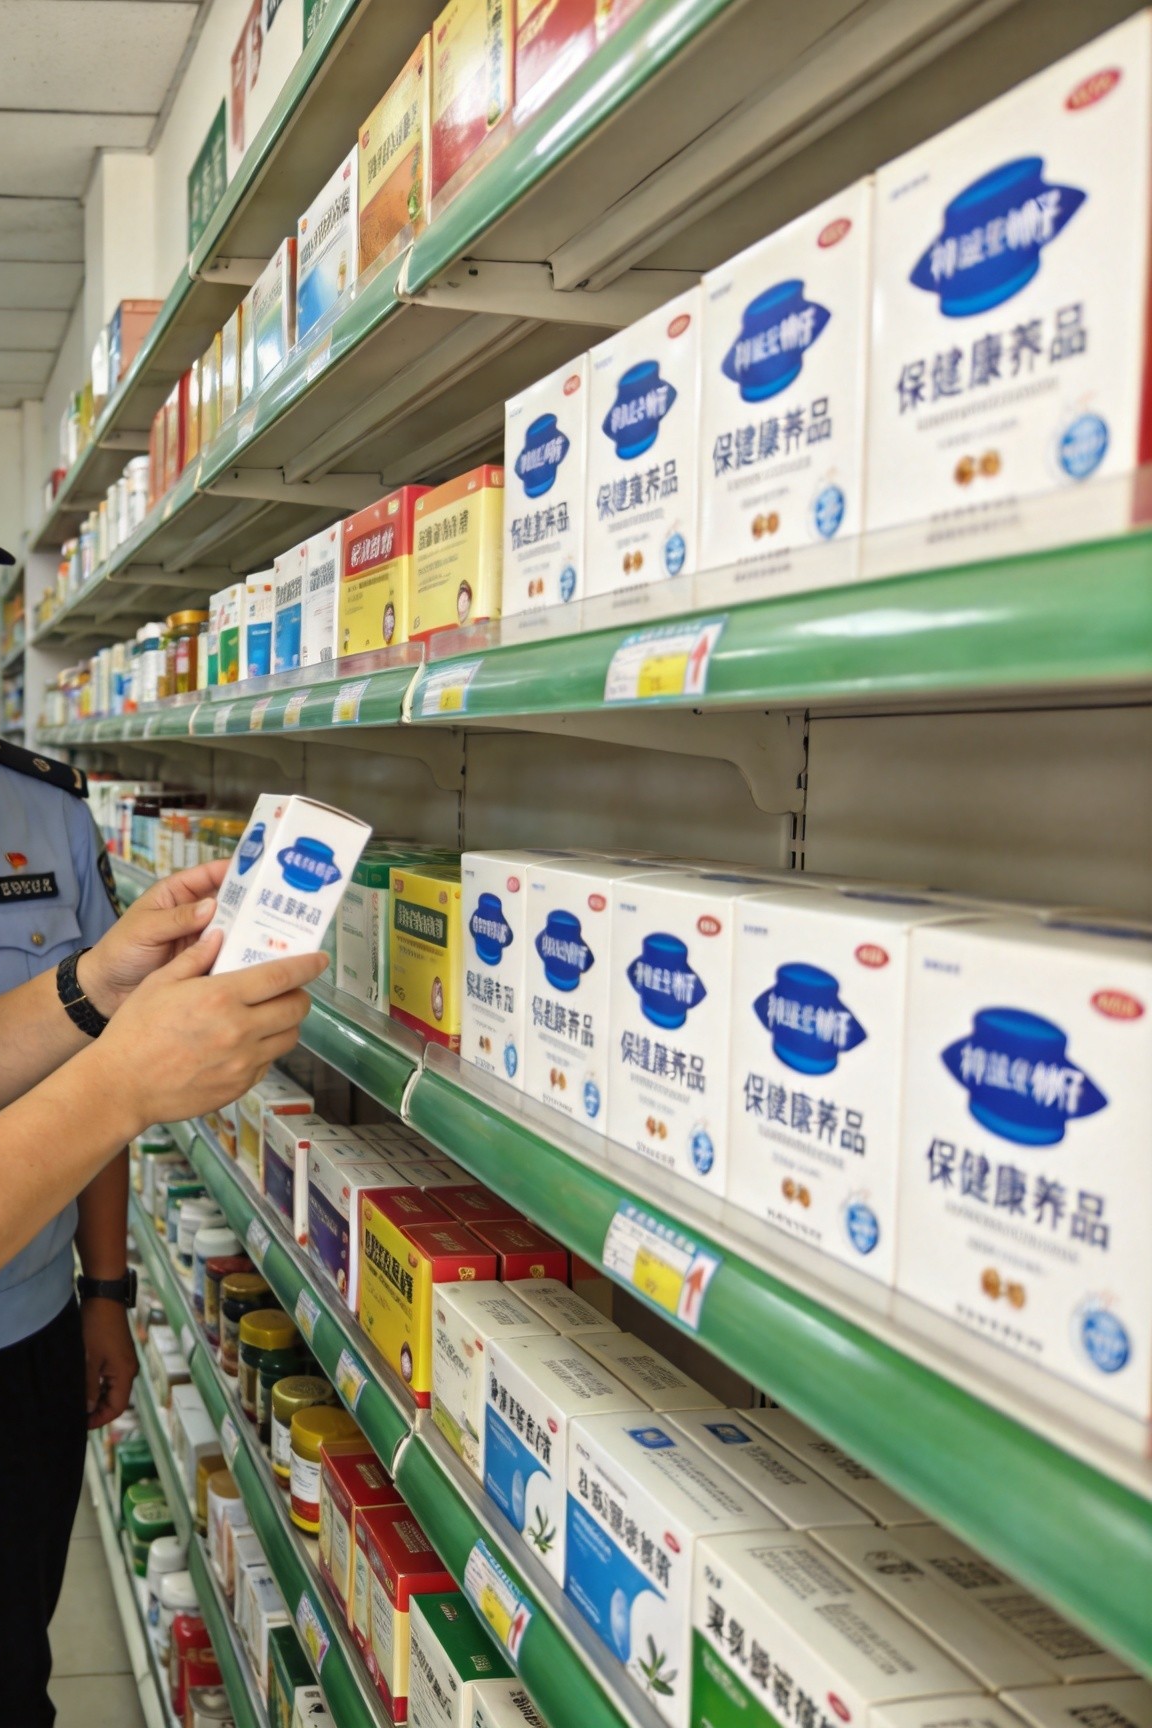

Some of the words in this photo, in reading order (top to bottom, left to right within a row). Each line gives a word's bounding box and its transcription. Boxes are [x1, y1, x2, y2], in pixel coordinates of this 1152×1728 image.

[897, 302, 1087, 414] 保健康养品
[927, 1137, 1110, 1250] 保健康养品
